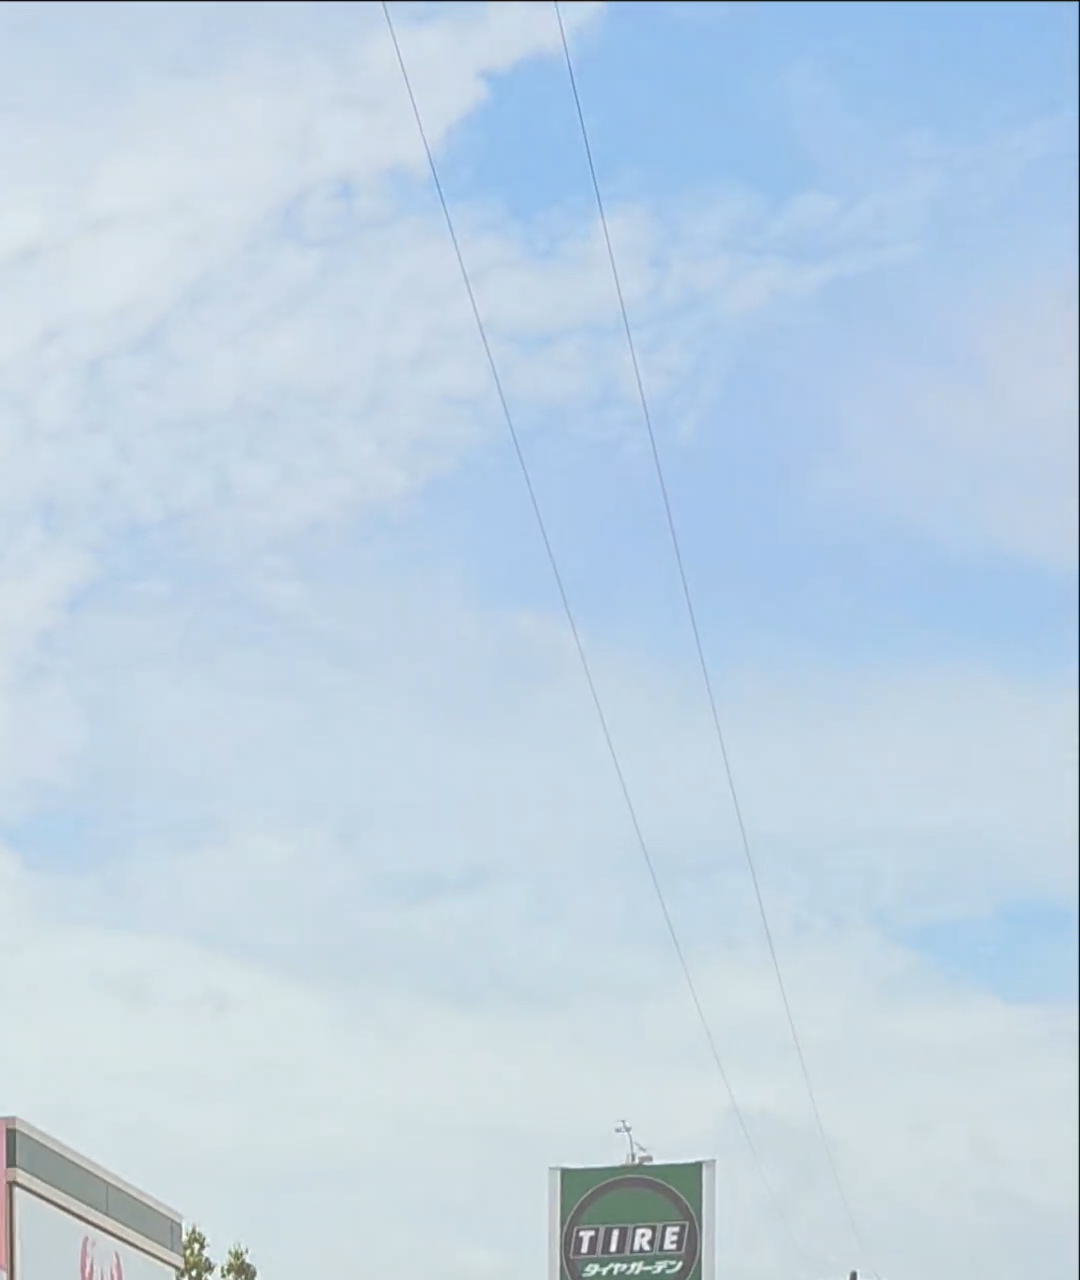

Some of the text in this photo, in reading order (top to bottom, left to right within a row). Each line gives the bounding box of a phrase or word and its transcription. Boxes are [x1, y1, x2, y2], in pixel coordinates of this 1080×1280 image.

[578, 1226, 681, 1254] TIRE
[582, 1260, 684, 1277] タイヤガーデン
